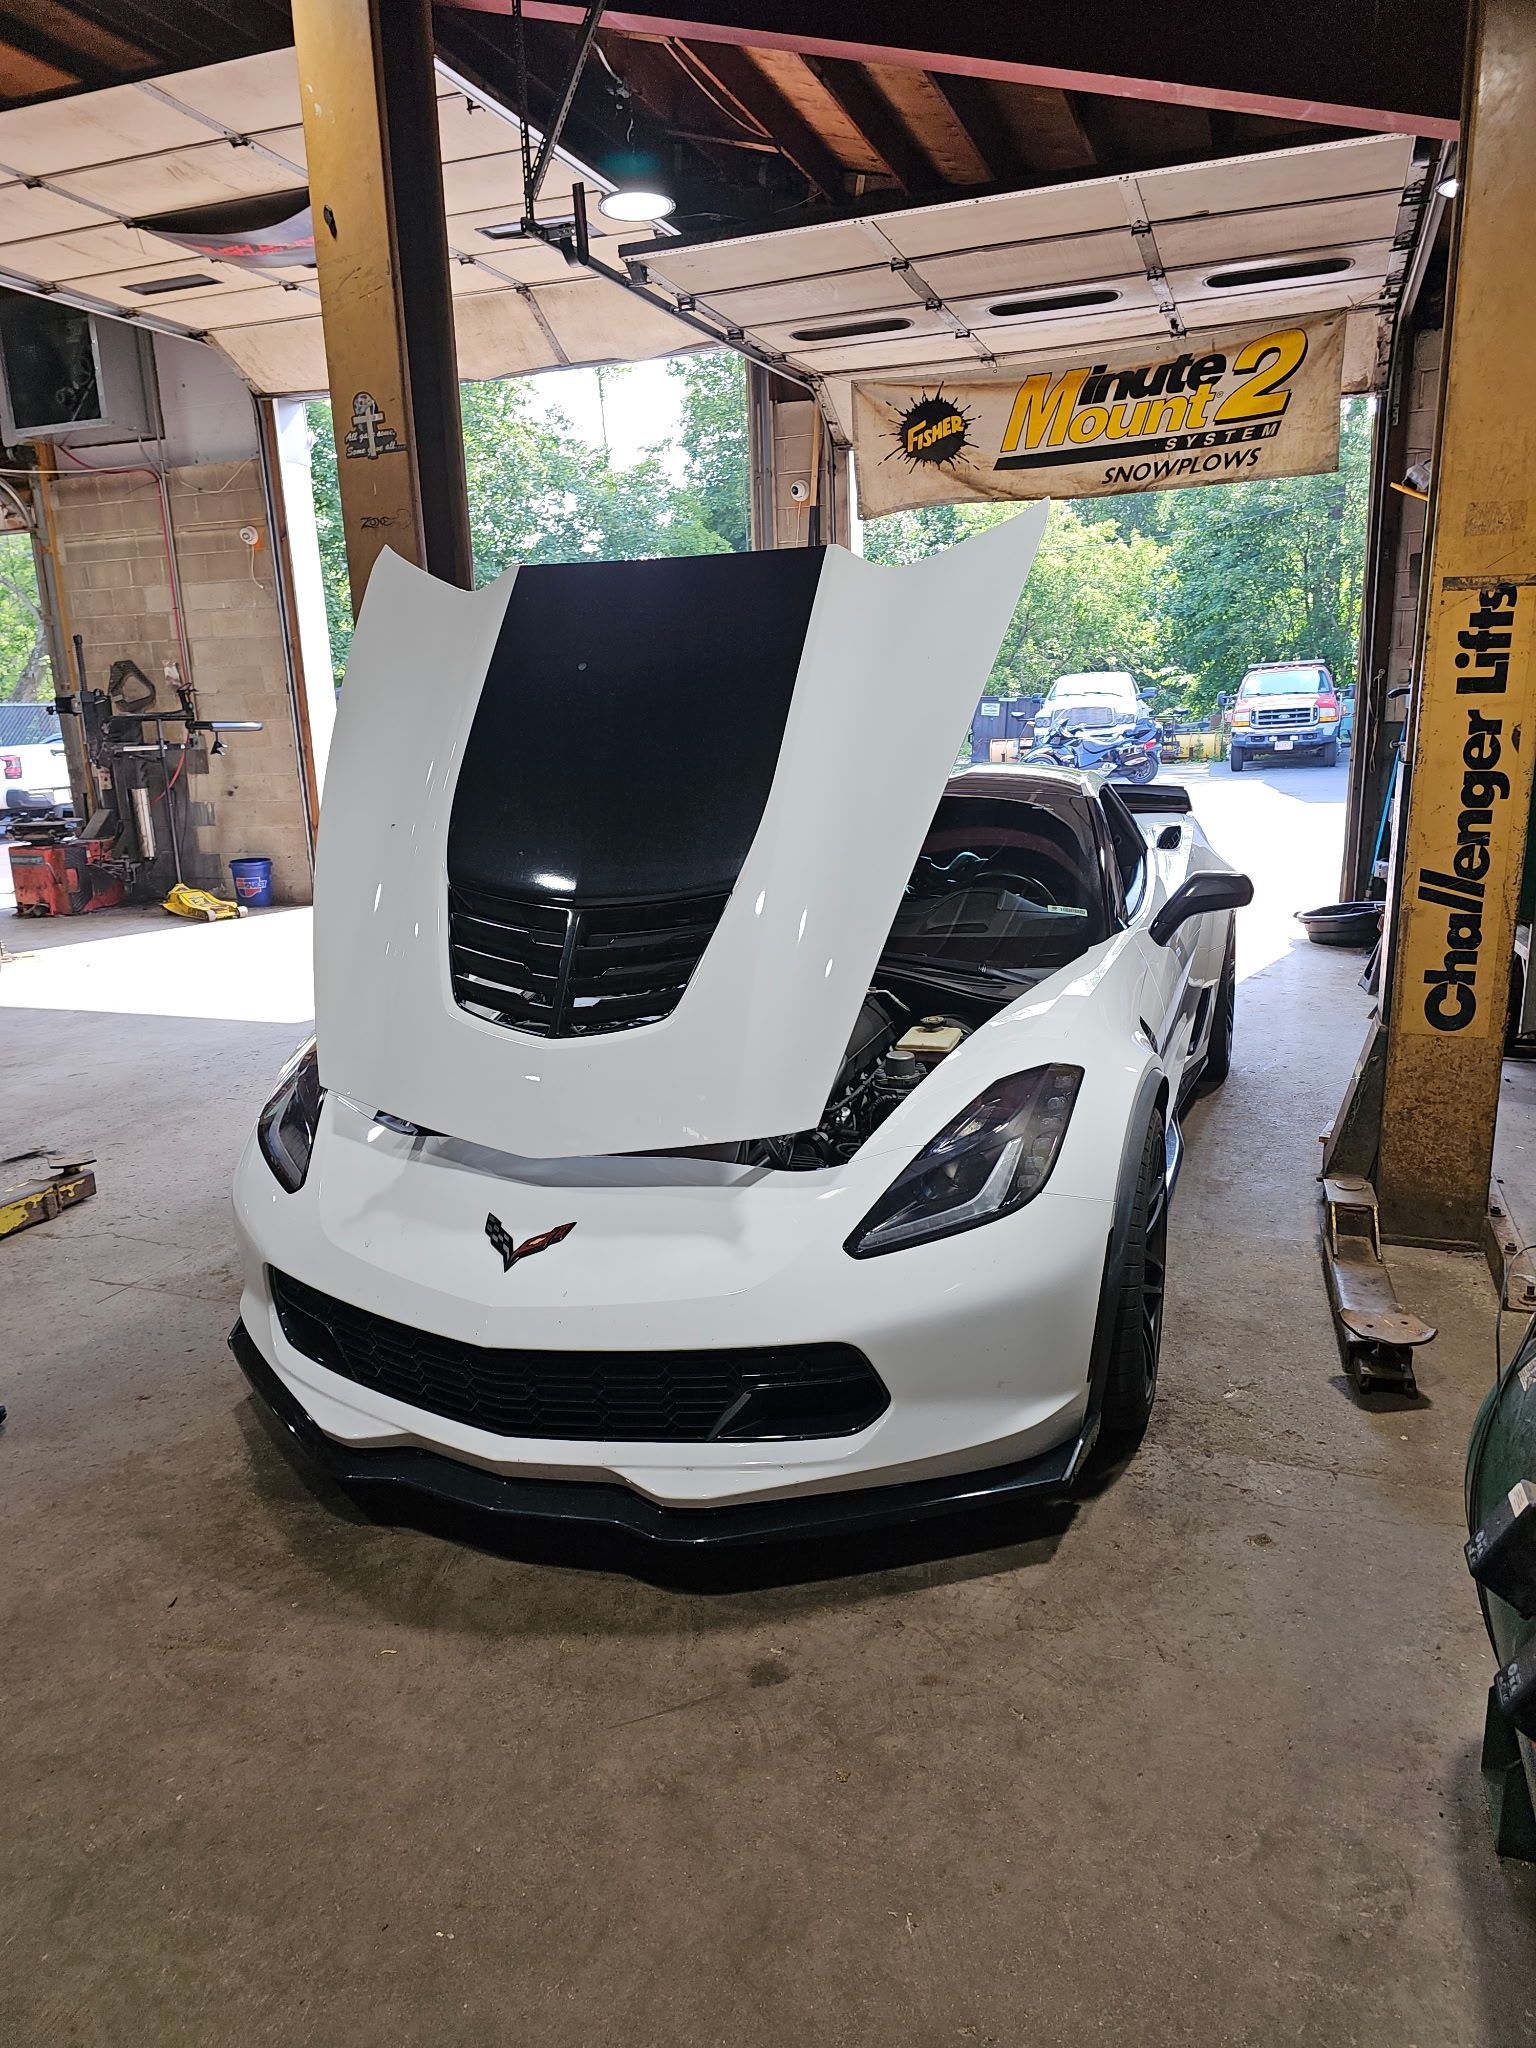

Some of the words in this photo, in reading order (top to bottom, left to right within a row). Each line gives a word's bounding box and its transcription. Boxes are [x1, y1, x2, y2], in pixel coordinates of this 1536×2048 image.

[1000, 353, 1227, 452] Minute
[1214, 327, 1309, 425] 2
[345, 432, 358, 443] All
[1102, 447, 1262, 485] SNOWPLOWS
[1165, 423, 1278, 451] SYSTEM
[1455, 583, 1518, 694] Lifts
[1418, 709, 1511, 1032] Challenger
